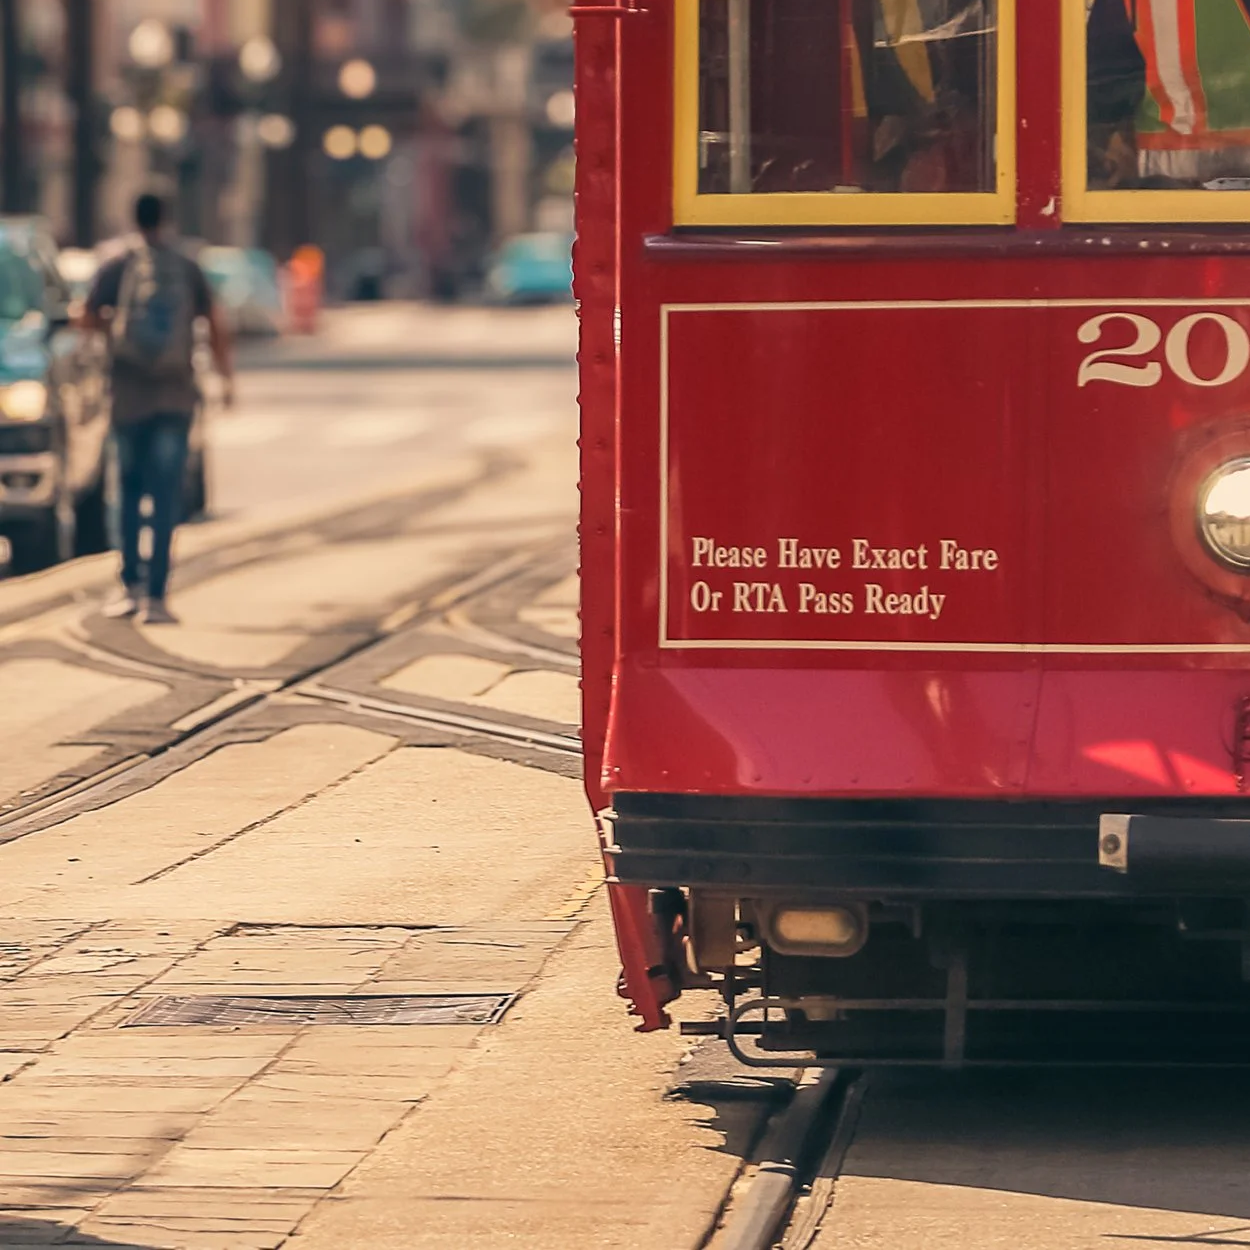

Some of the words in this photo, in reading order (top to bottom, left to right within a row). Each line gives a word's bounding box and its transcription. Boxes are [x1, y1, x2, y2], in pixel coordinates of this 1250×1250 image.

[691, 536, 768, 568] Please
[777, 538, 841, 569] Have
[852, 538, 929, 570] Exact
[939, 539, 999, 571] Fare
[690, 580, 723, 612] Or
[731, 582, 788, 613] RTA
[798, 582, 854, 614] Pass
[864, 583, 946, 621] Ready
